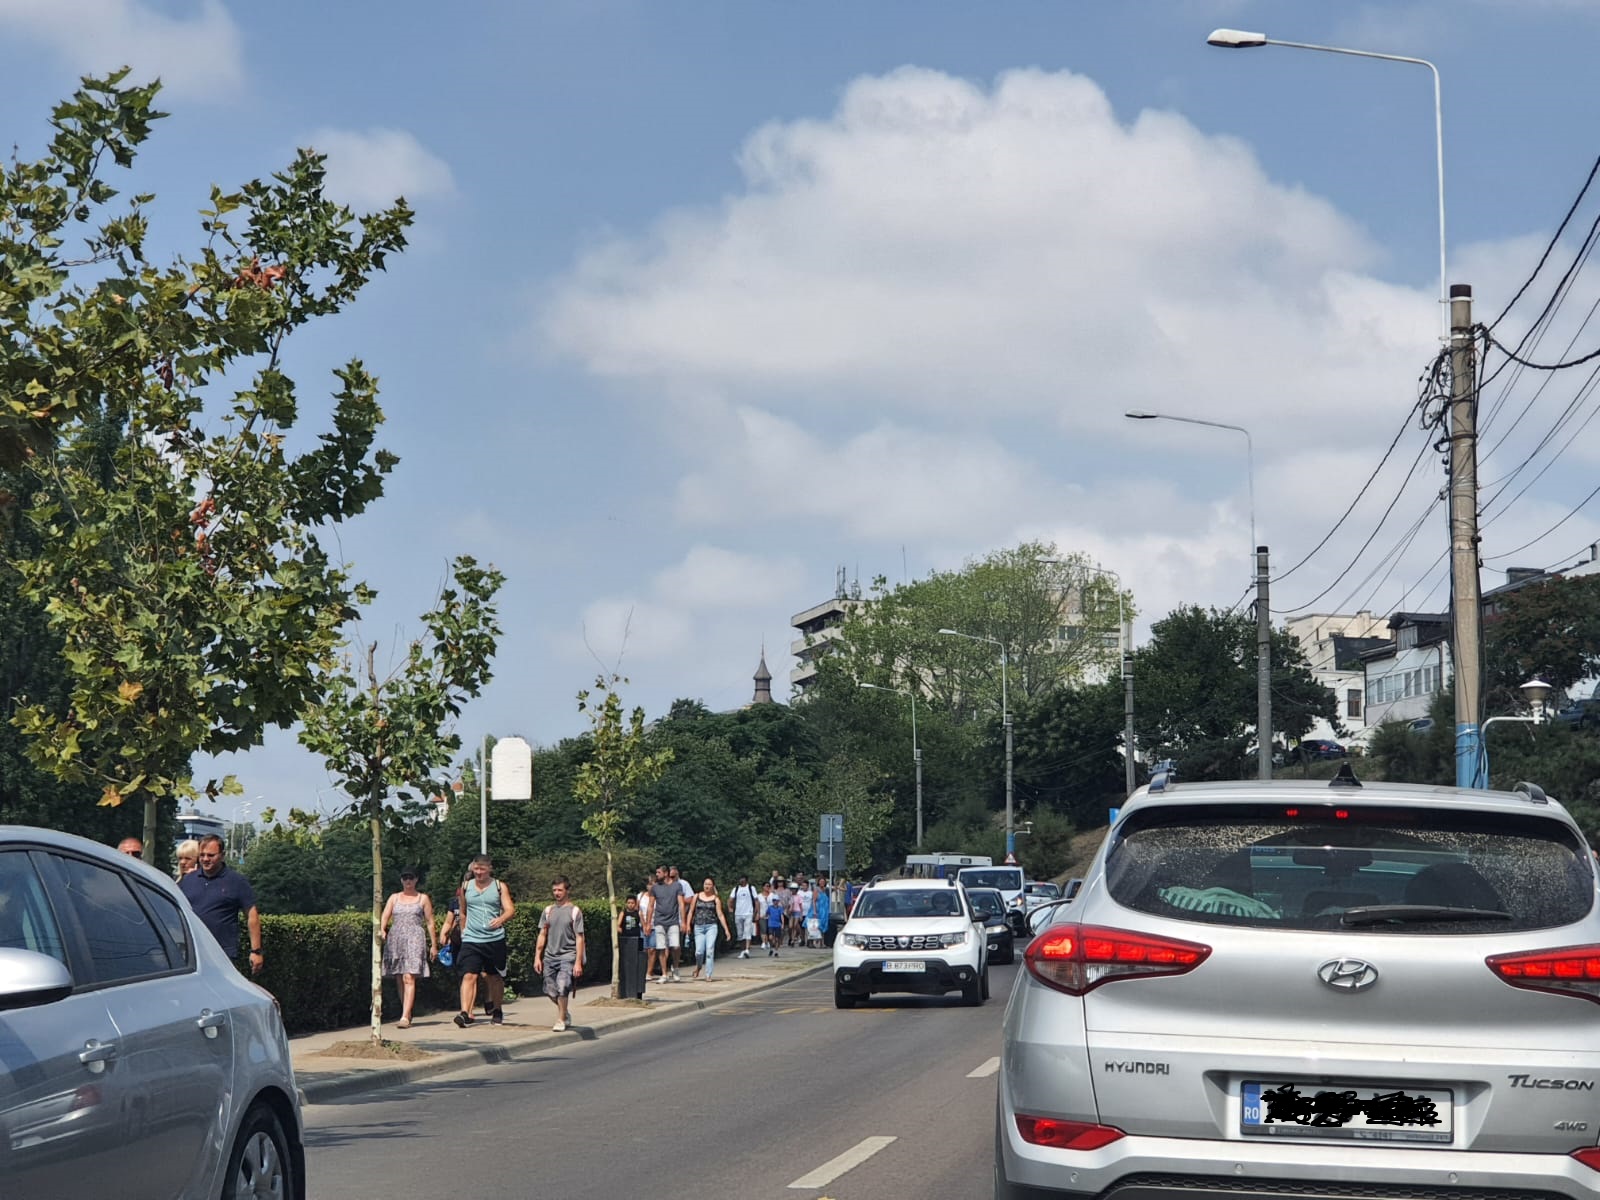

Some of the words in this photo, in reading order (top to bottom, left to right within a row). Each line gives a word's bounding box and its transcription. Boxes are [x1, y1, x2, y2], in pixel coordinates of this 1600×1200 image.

[1104, 1061, 1170, 1076] HYUNDAI
[1507, 1073, 1595, 1091] TUCSON
[1244, 1106, 1259, 1120] RO
[1553, 1121, 1588, 1132] 4WD
